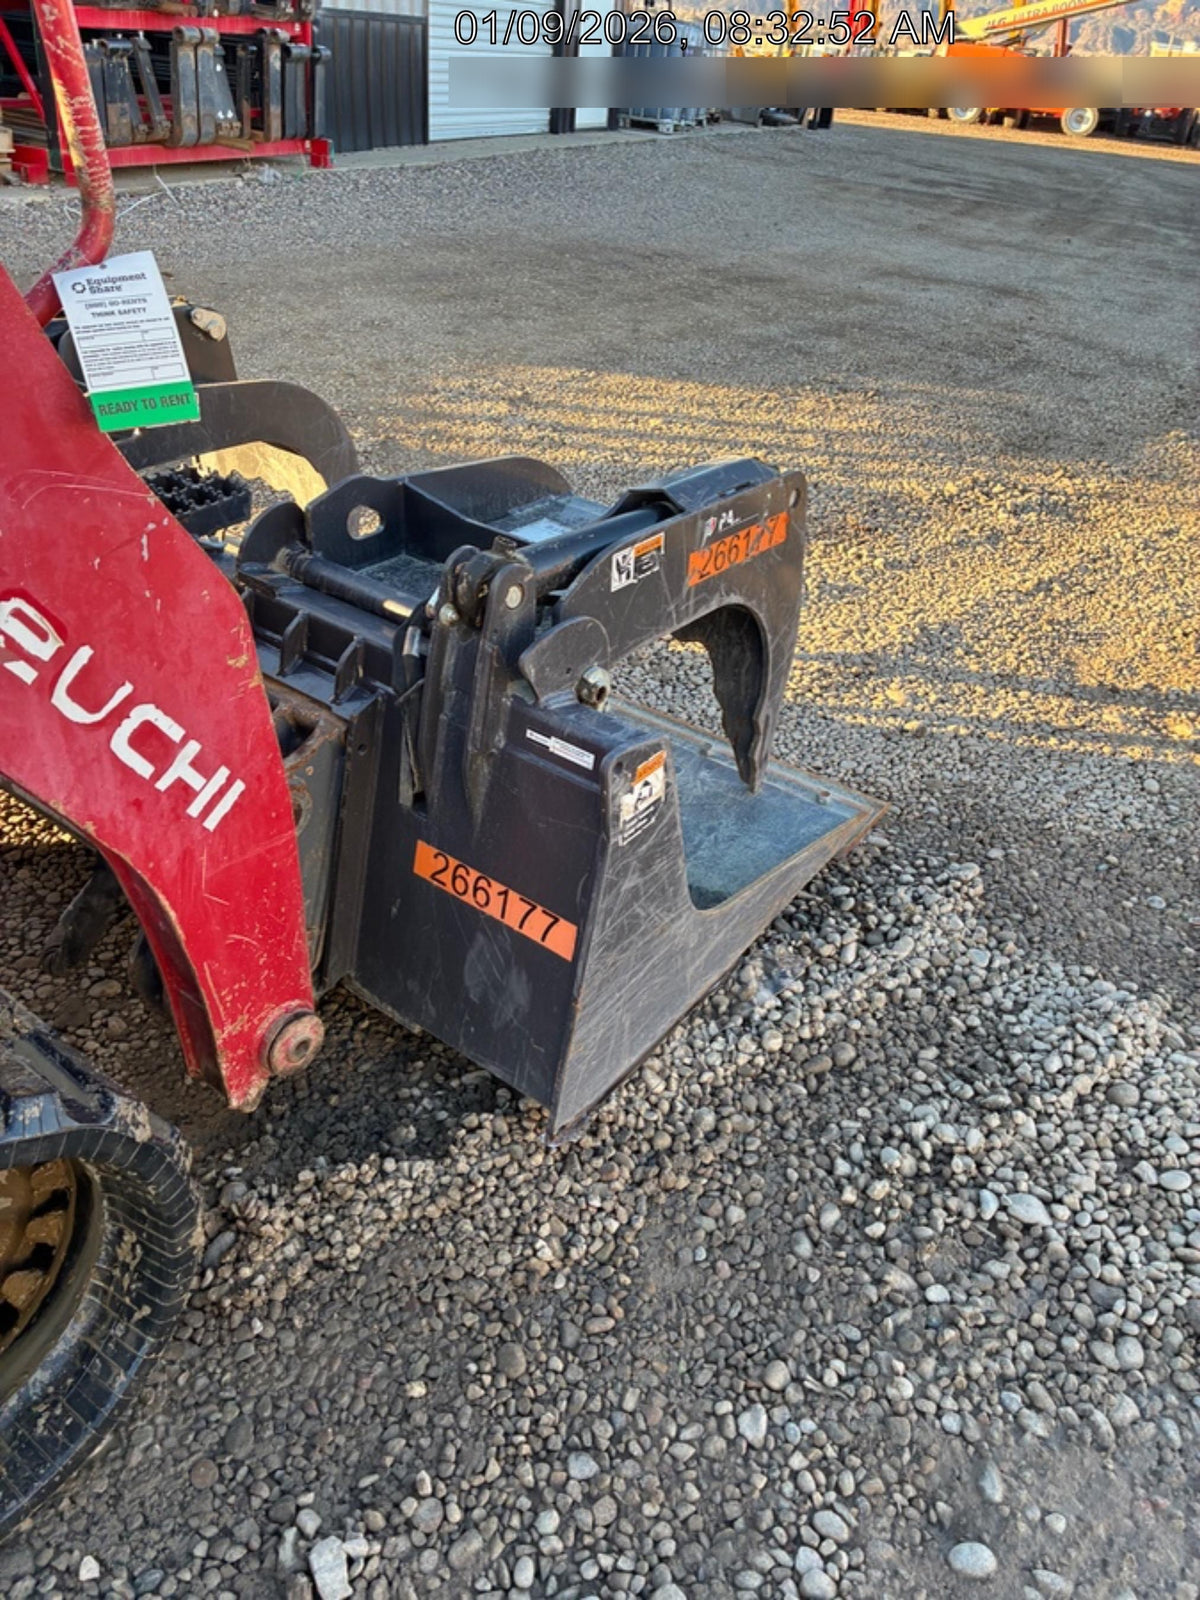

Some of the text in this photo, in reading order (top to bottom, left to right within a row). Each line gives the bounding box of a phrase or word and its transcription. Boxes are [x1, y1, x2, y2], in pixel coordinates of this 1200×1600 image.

[86, 272, 147, 286] Equipment
[88, 285, 123, 294] Share
[91, 307, 147, 318] THINK SAFETY
[98, 393, 191, 416] READY TO RENT
[429, 852, 560, 943] 266177
